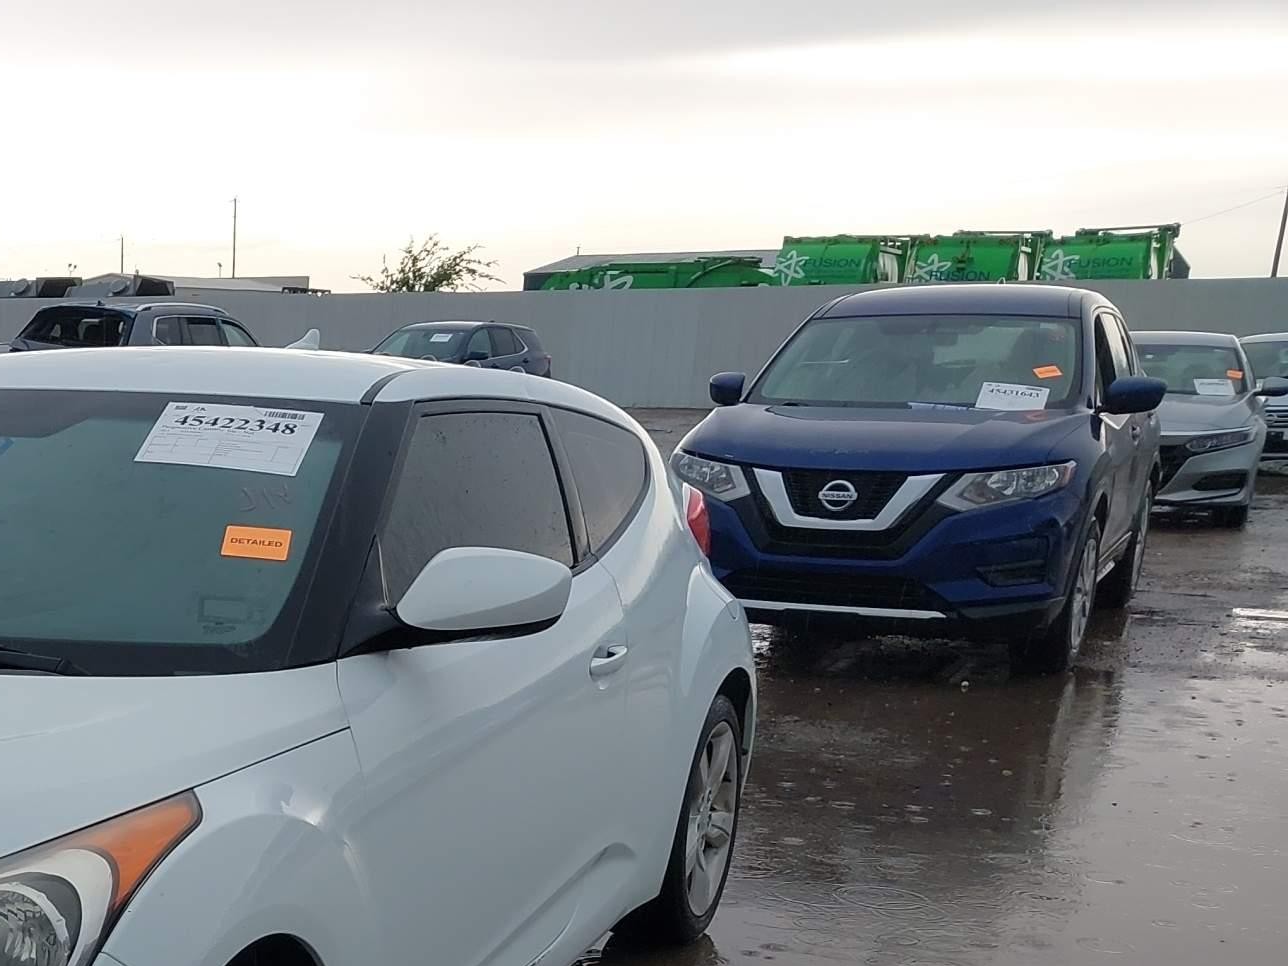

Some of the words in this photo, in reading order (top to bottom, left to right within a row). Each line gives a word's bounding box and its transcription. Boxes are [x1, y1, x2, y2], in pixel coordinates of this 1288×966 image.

[804, 257, 861, 269] FUSION
[1068, 257, 1133, 269] FUSION
[174, 414, 298, 435] 45422348
[230, 537, 283, 548] DETAILED
